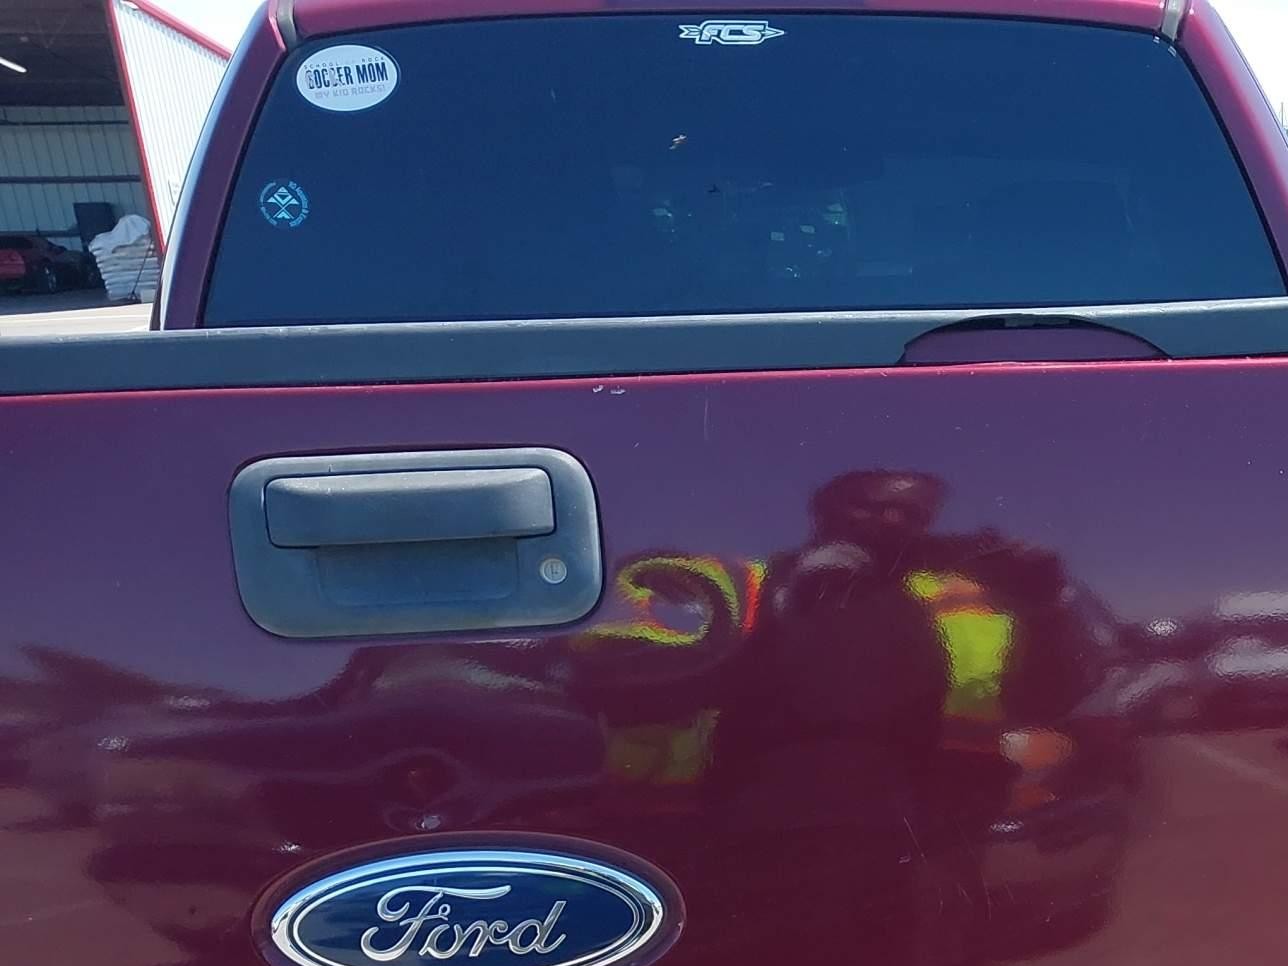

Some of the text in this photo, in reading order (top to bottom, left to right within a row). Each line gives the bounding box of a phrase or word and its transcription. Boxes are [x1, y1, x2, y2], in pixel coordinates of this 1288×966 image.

[700, 23, 765, 41] FCS
[356, 62, 389, 84] MOM
[360, 884, 567, 961] Ford
